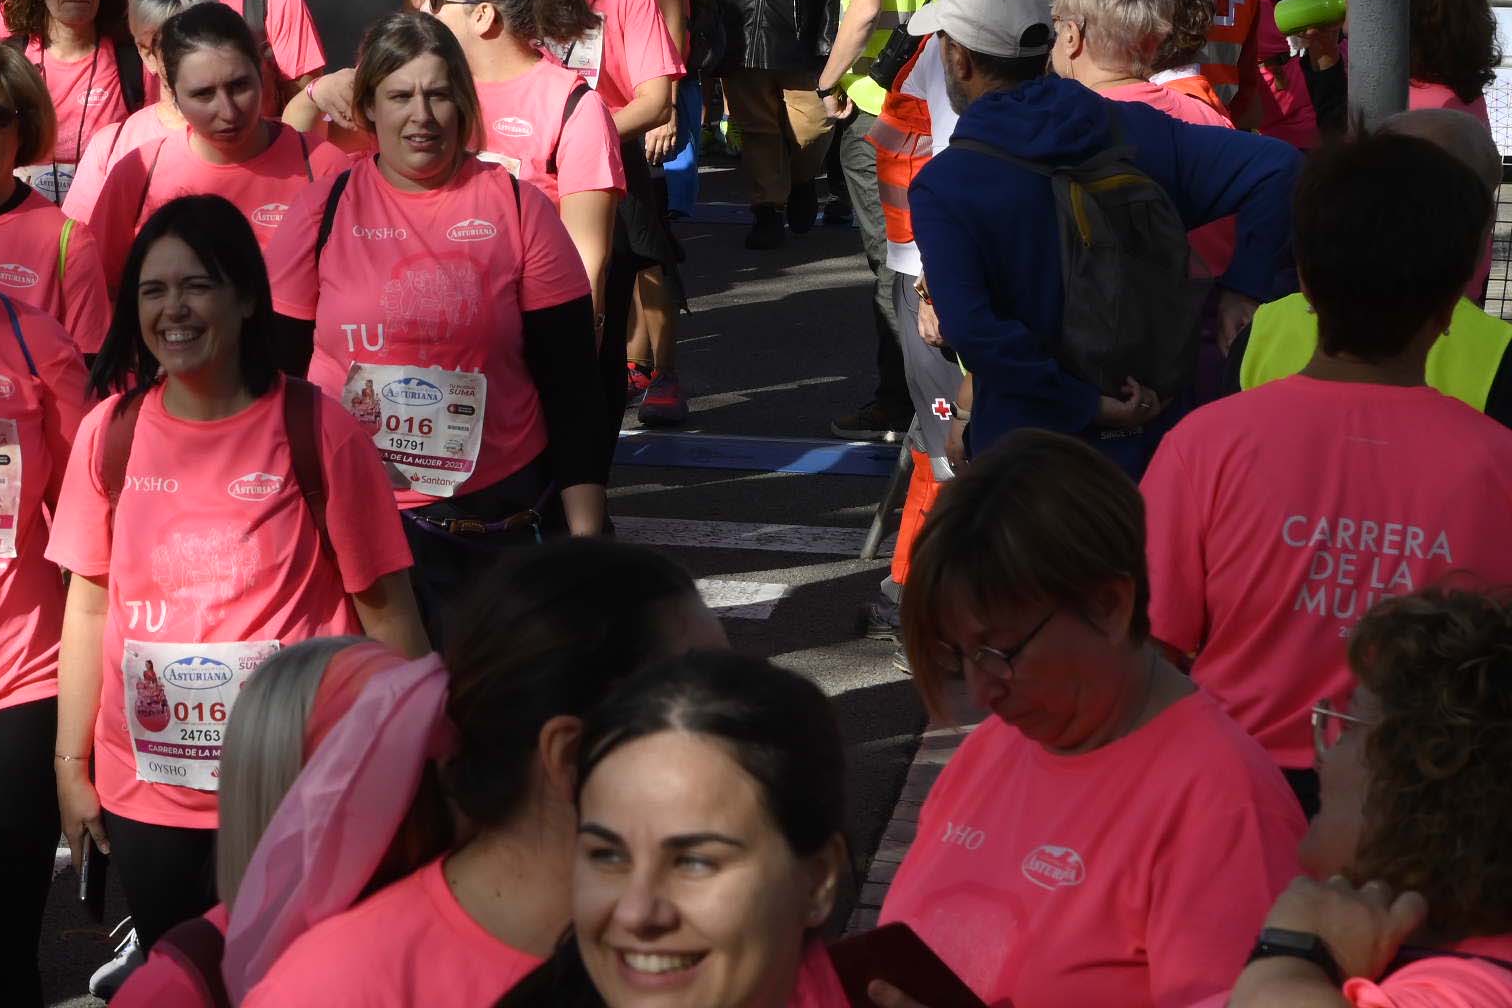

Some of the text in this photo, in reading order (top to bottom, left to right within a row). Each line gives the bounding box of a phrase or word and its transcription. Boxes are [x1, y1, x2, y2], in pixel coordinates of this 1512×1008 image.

[352, 224, 408, 241] OYSHO
[340, 323, 385, 353] TU
[385, 415, 433, 435] 016
[389, 437, 425, 452] 19791
[390, 453, 402, 461] DE
[403, 455, 413, 463] LA
[414, 457, 442, 467] MUJER
[1282, 515, 1453, 564] CARRERA
[1309, 550, 1416, 592] DE LA
[125, 600, 168, 633] TU
[169, 669, 228, 682] ASTURIANA
[173, 702, 226, 722] 016
[180, 729, 221, 742] 24763
[148, 744, 184, 755] CARRERA
[185, 748, 197, 756] DE
[198, 749, 210, 757] LA
[148, 761, 187, 777] OYSHO
